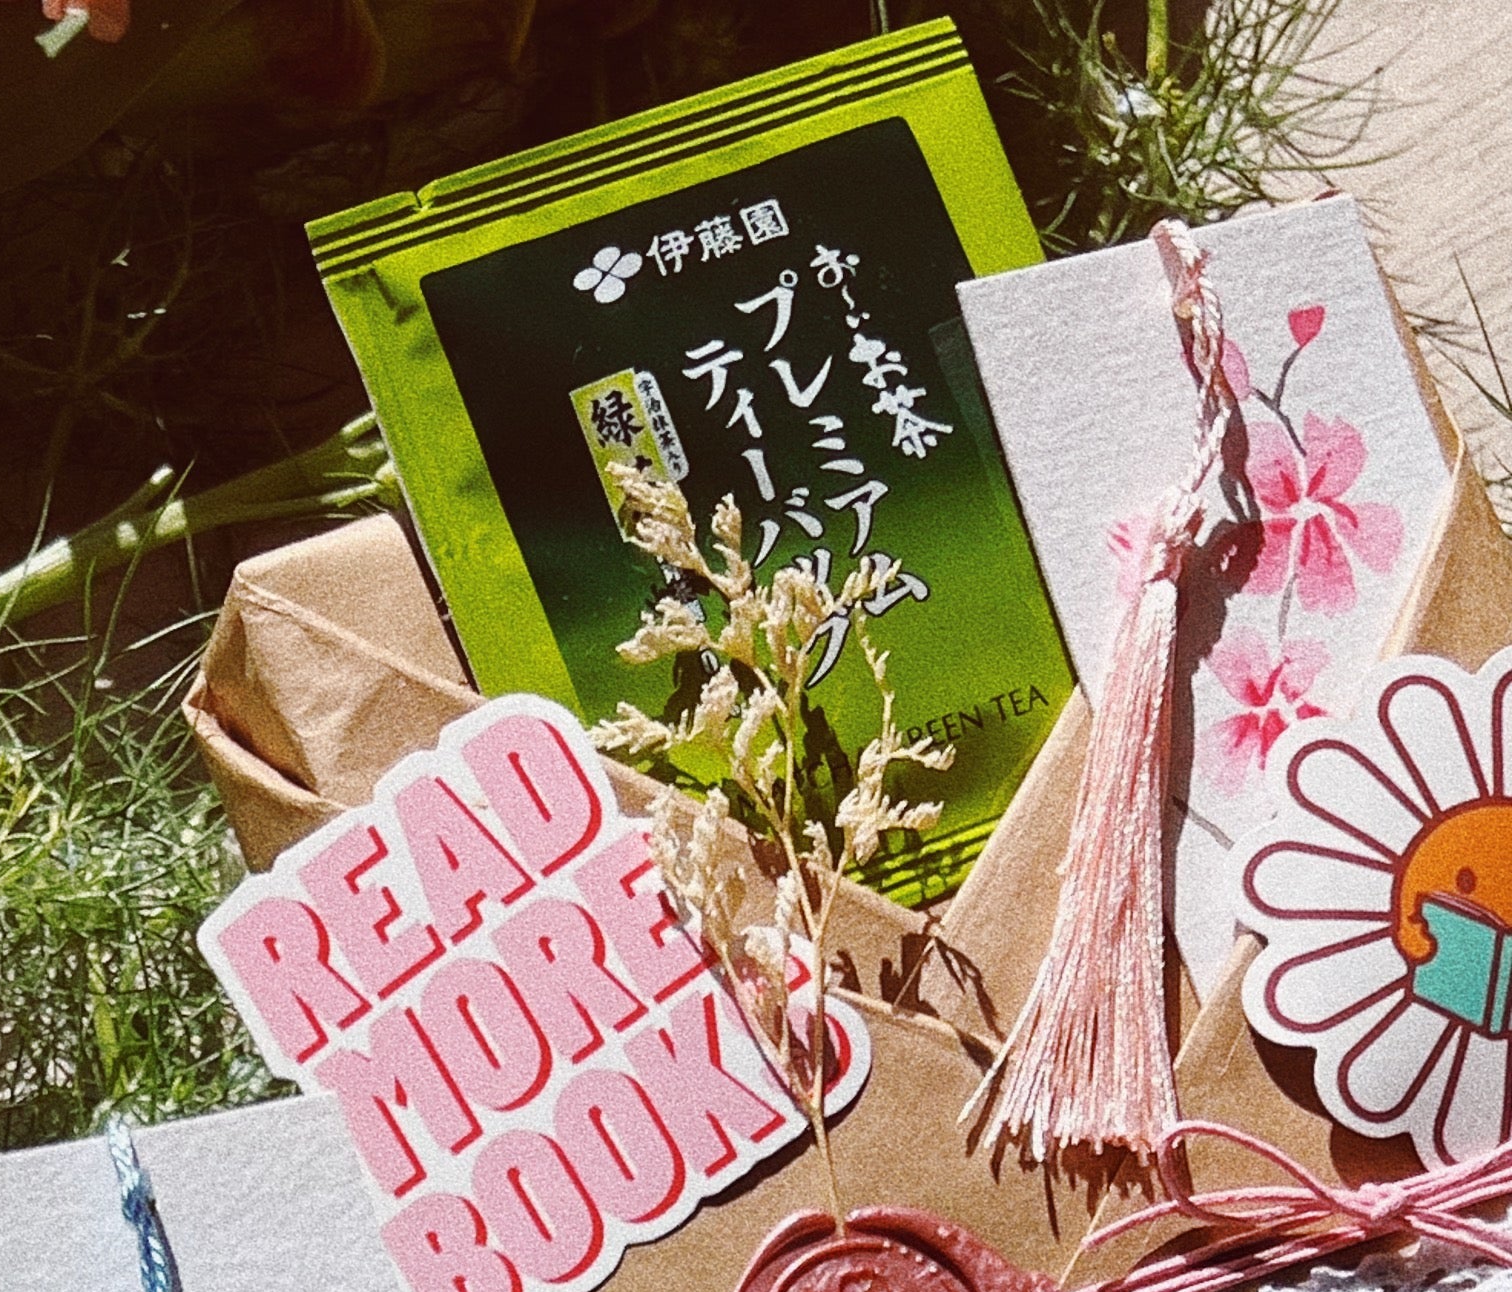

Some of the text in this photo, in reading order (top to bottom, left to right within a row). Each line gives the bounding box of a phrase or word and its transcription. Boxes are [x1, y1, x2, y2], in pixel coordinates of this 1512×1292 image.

[646, 199, 790, 277] 伊藤園
[905, 683, 1050, 748] REEN TEA
[217, 713, 604, 1065] READ
[315, 831, 722, 1198] MORE
